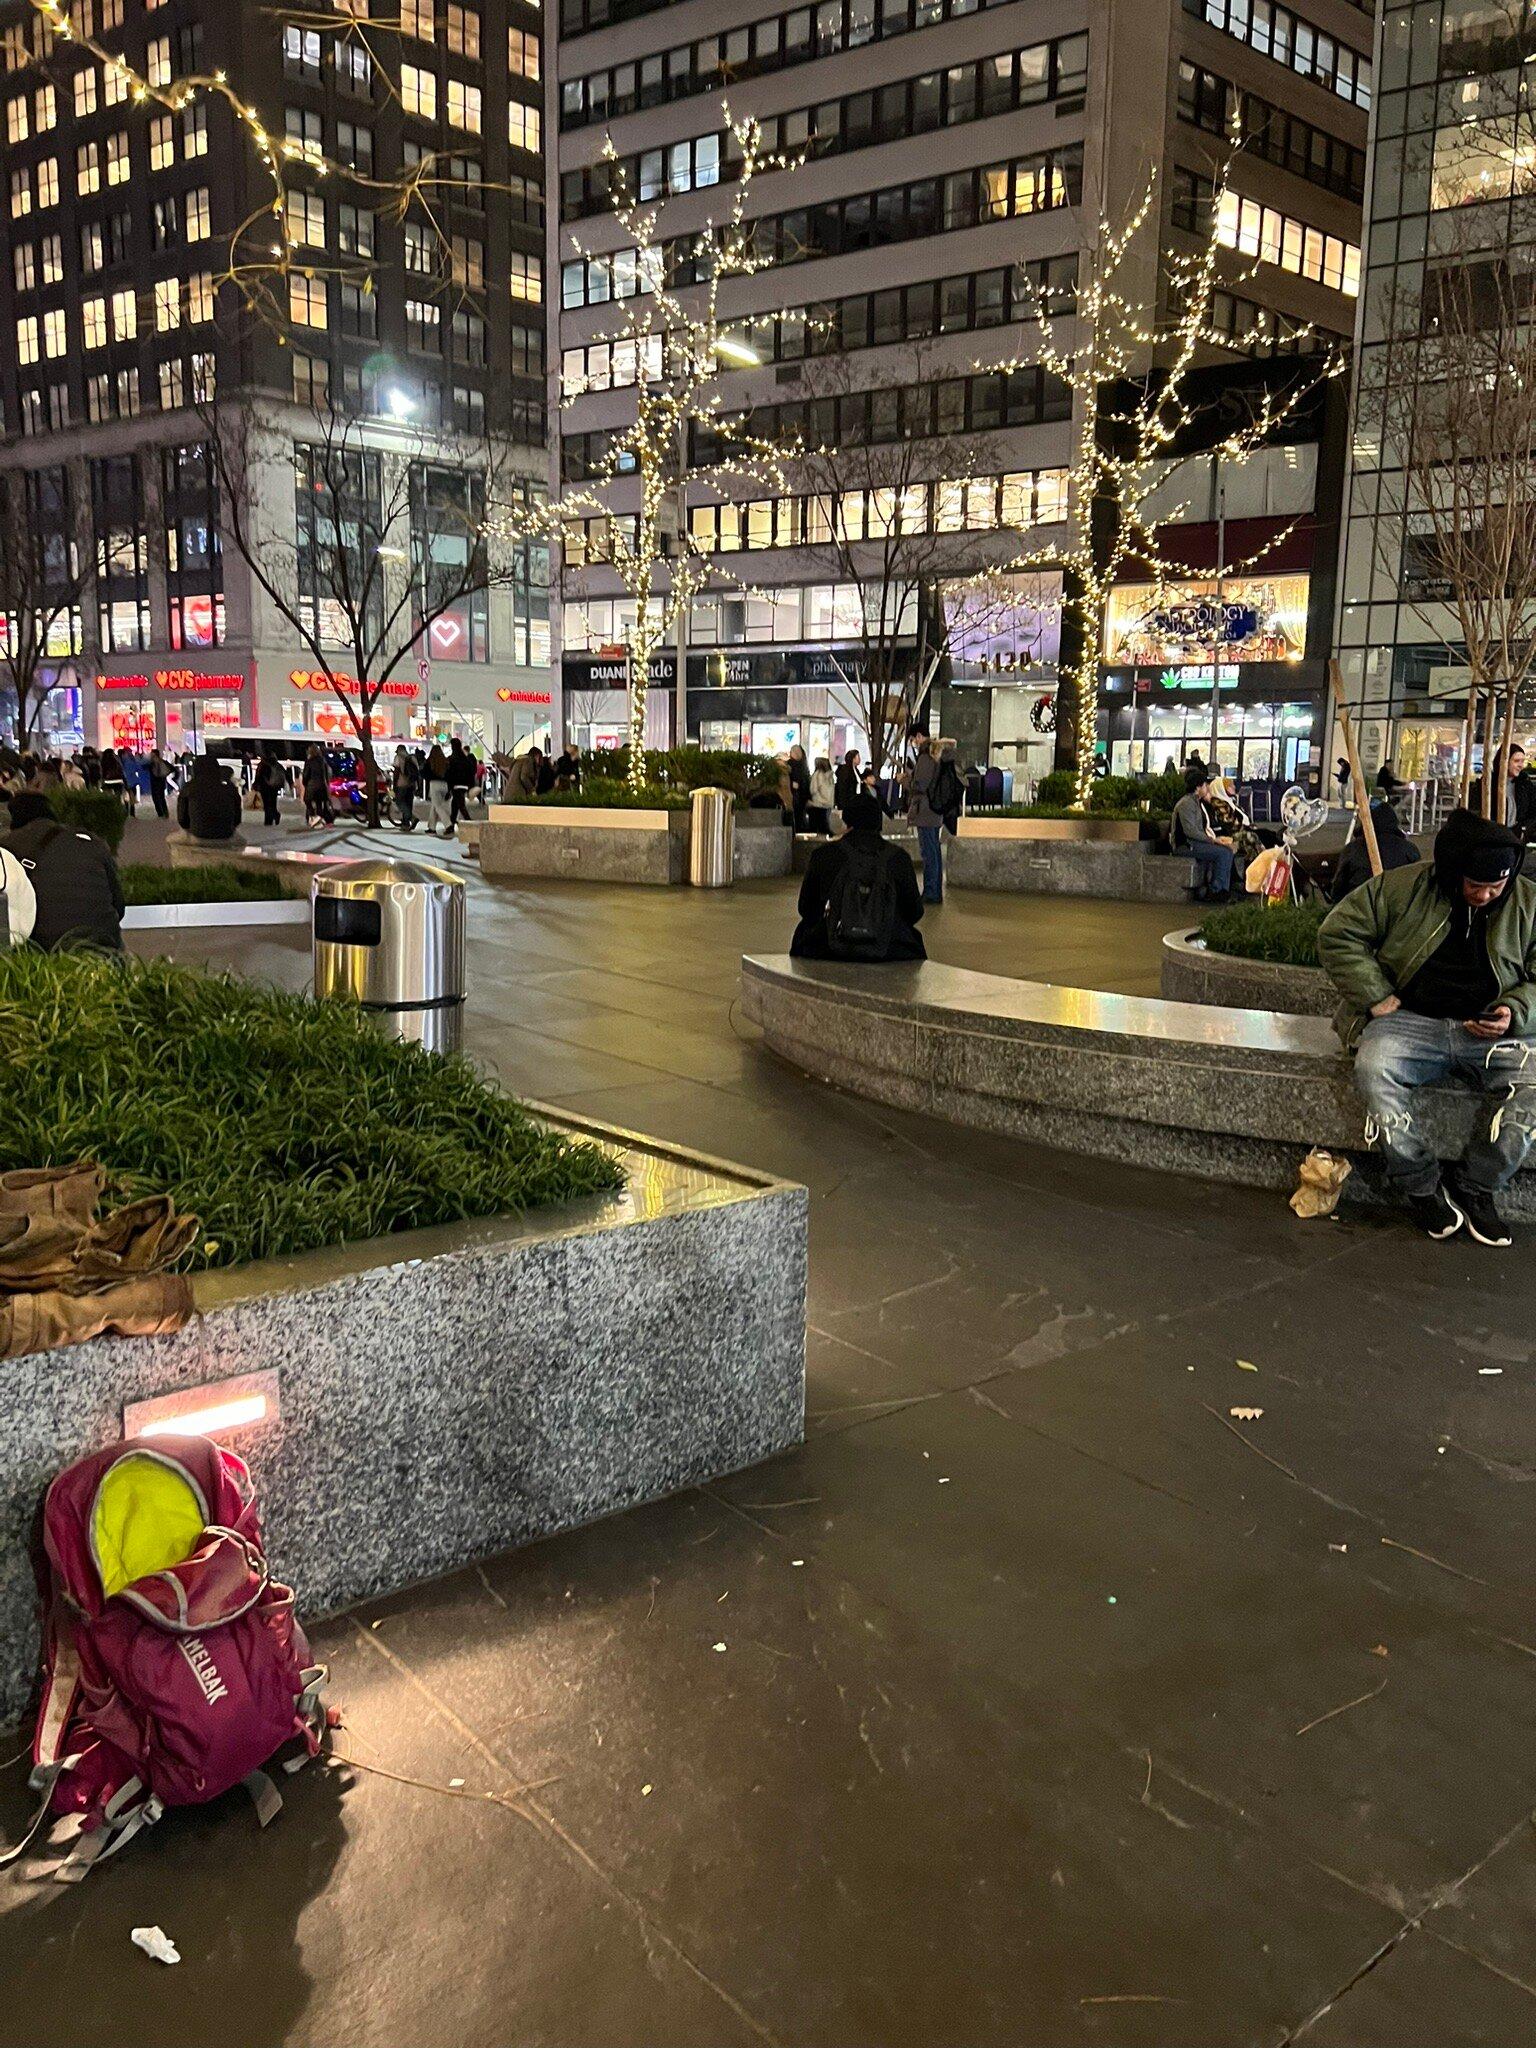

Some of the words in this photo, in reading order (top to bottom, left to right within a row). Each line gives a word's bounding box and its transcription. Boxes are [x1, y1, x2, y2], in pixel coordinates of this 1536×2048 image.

[590, 666, 629, 679] DUAN
[813, 659, 867, 675] pharmay
[168, 670, 194, 689] CVS
[195, 674, 244, 690] pharmacy
[339, 714, 385, 736] CS
